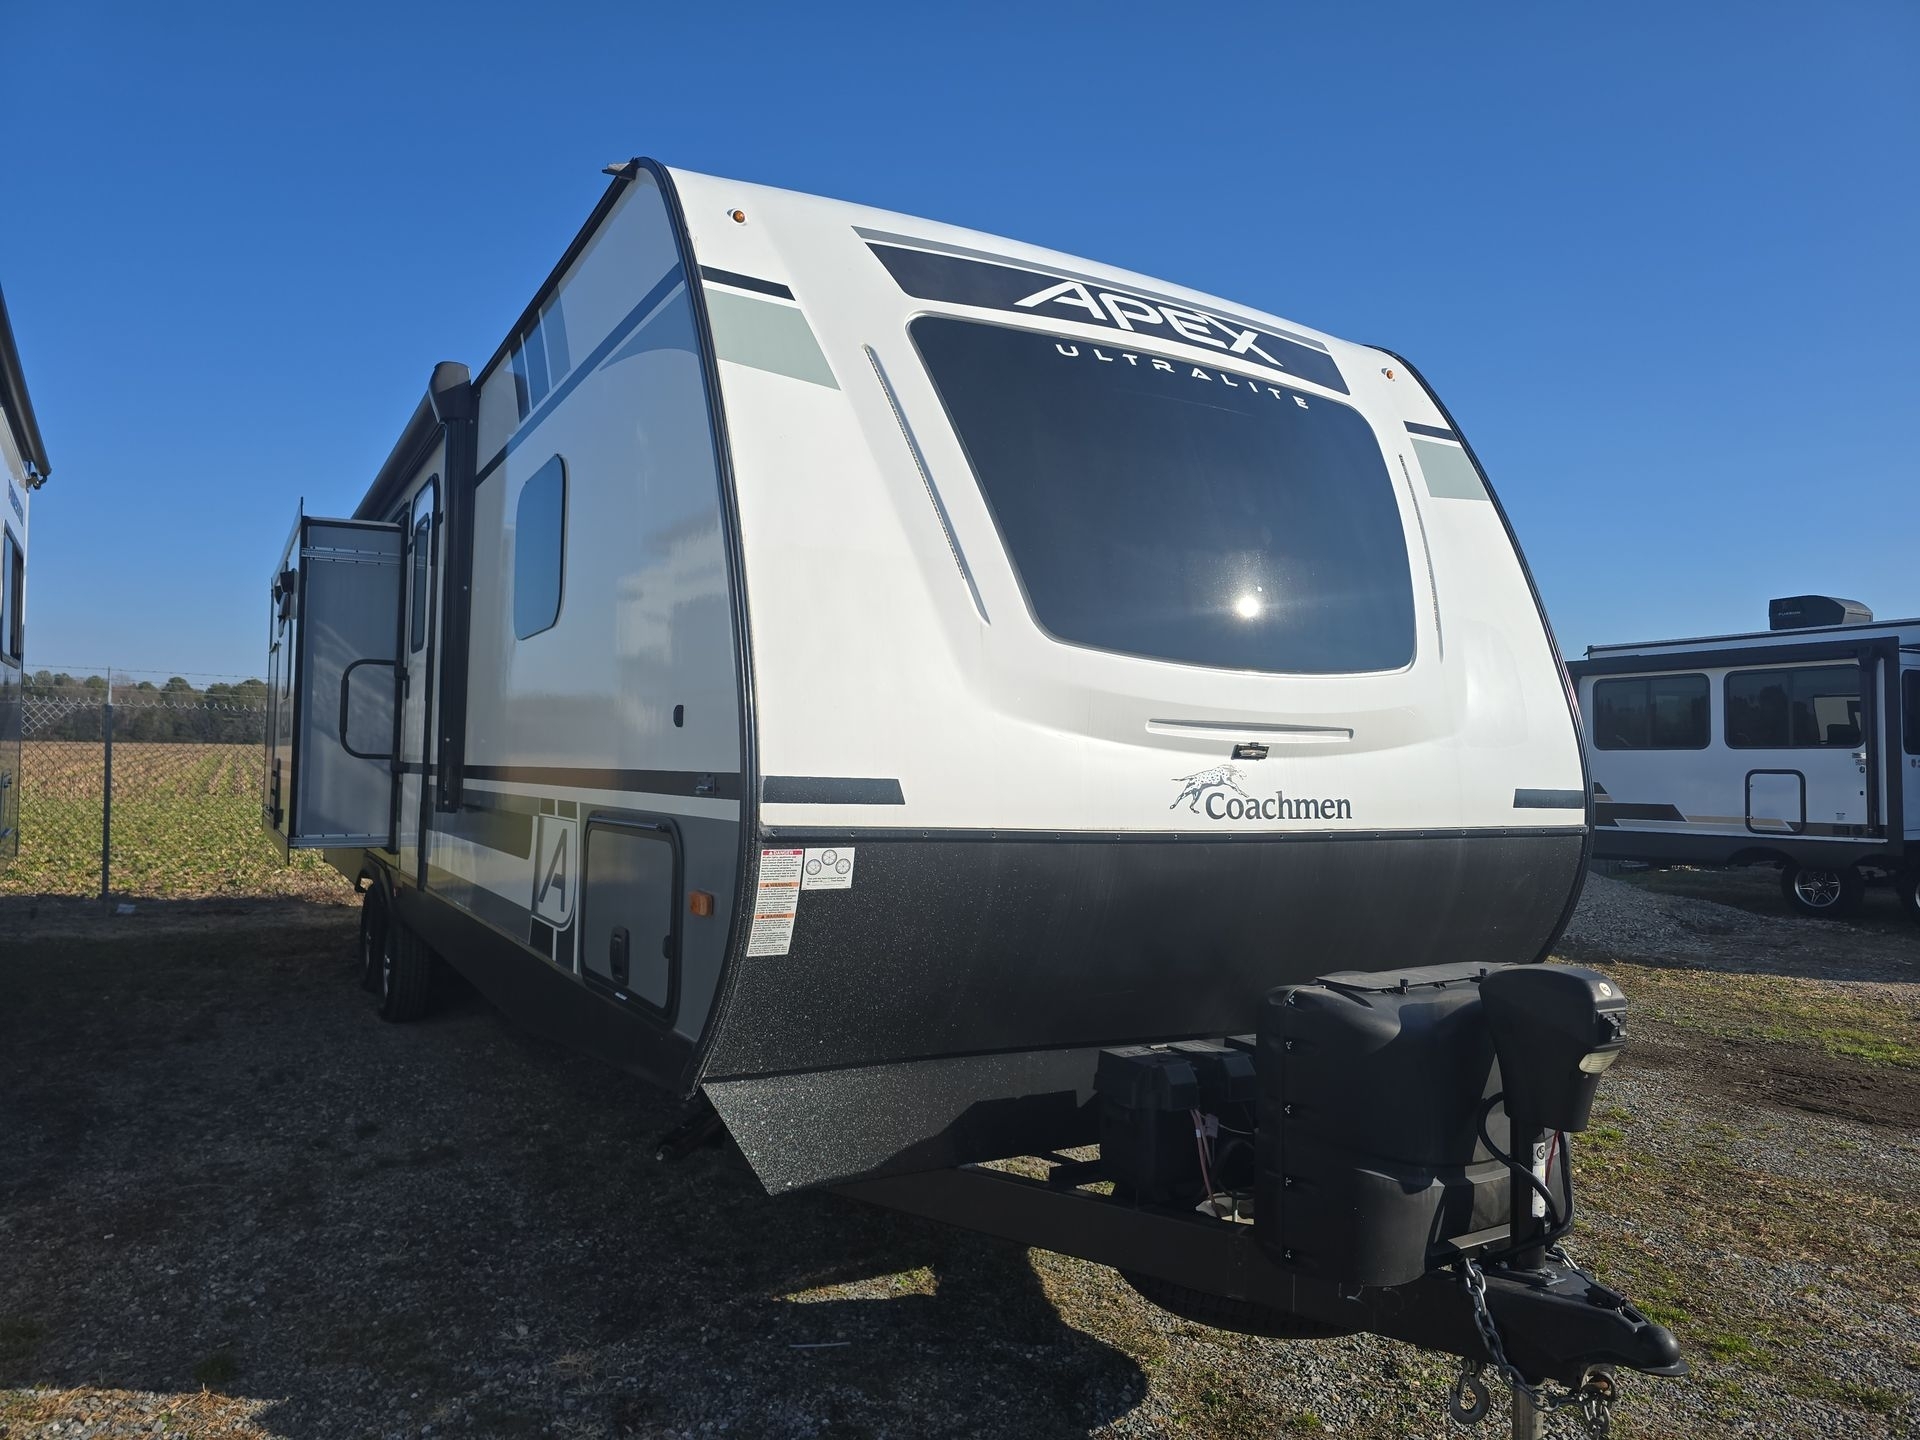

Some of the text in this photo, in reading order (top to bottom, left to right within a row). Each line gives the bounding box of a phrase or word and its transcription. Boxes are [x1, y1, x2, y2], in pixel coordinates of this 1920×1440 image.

[1013, 280, 1284, 367] APEX
[1055, 343, 1309, 410] ULTRALITE
[1205, 790, 1353, 820] Coachmen
